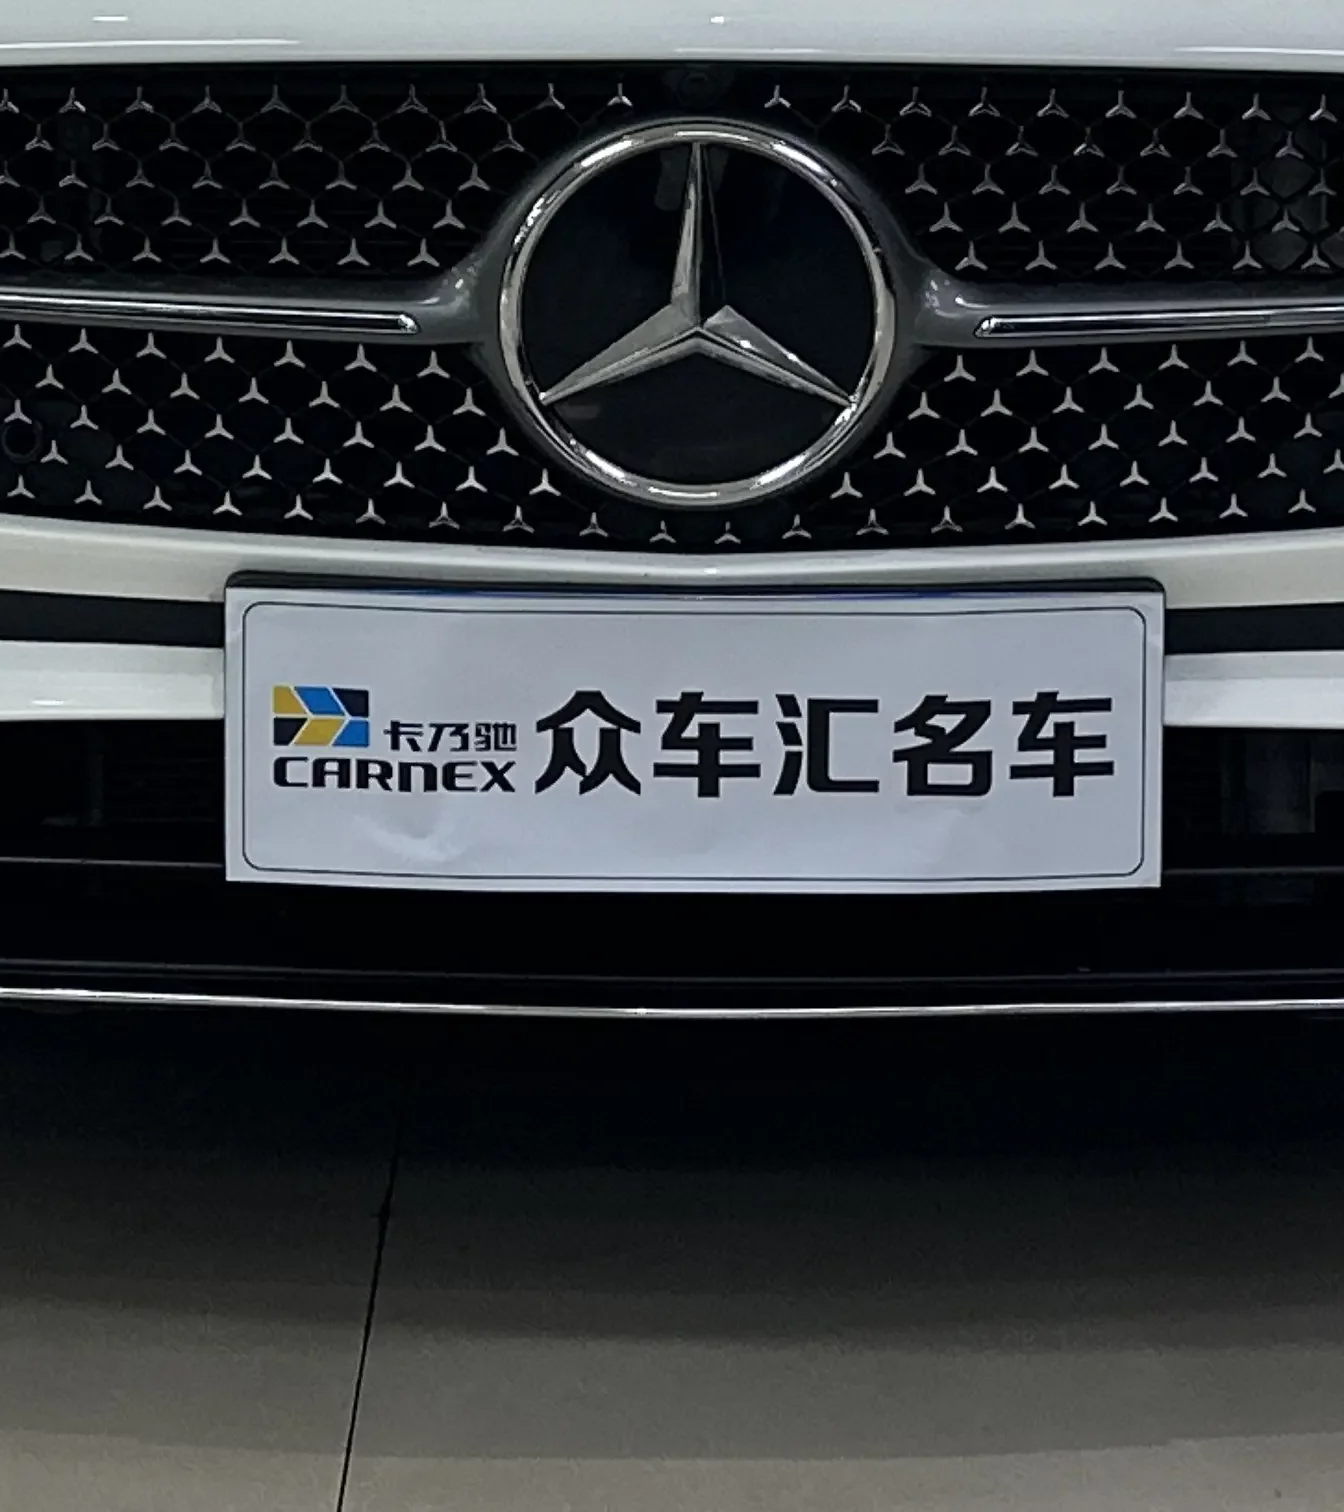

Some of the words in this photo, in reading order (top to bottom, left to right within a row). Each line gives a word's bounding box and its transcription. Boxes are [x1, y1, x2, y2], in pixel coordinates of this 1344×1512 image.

[383, 720, 517, 752] 卡乃驰
[534, 690, 1115, 797] 众车汇名车
[273, 756, 516, 792] CARNEX
